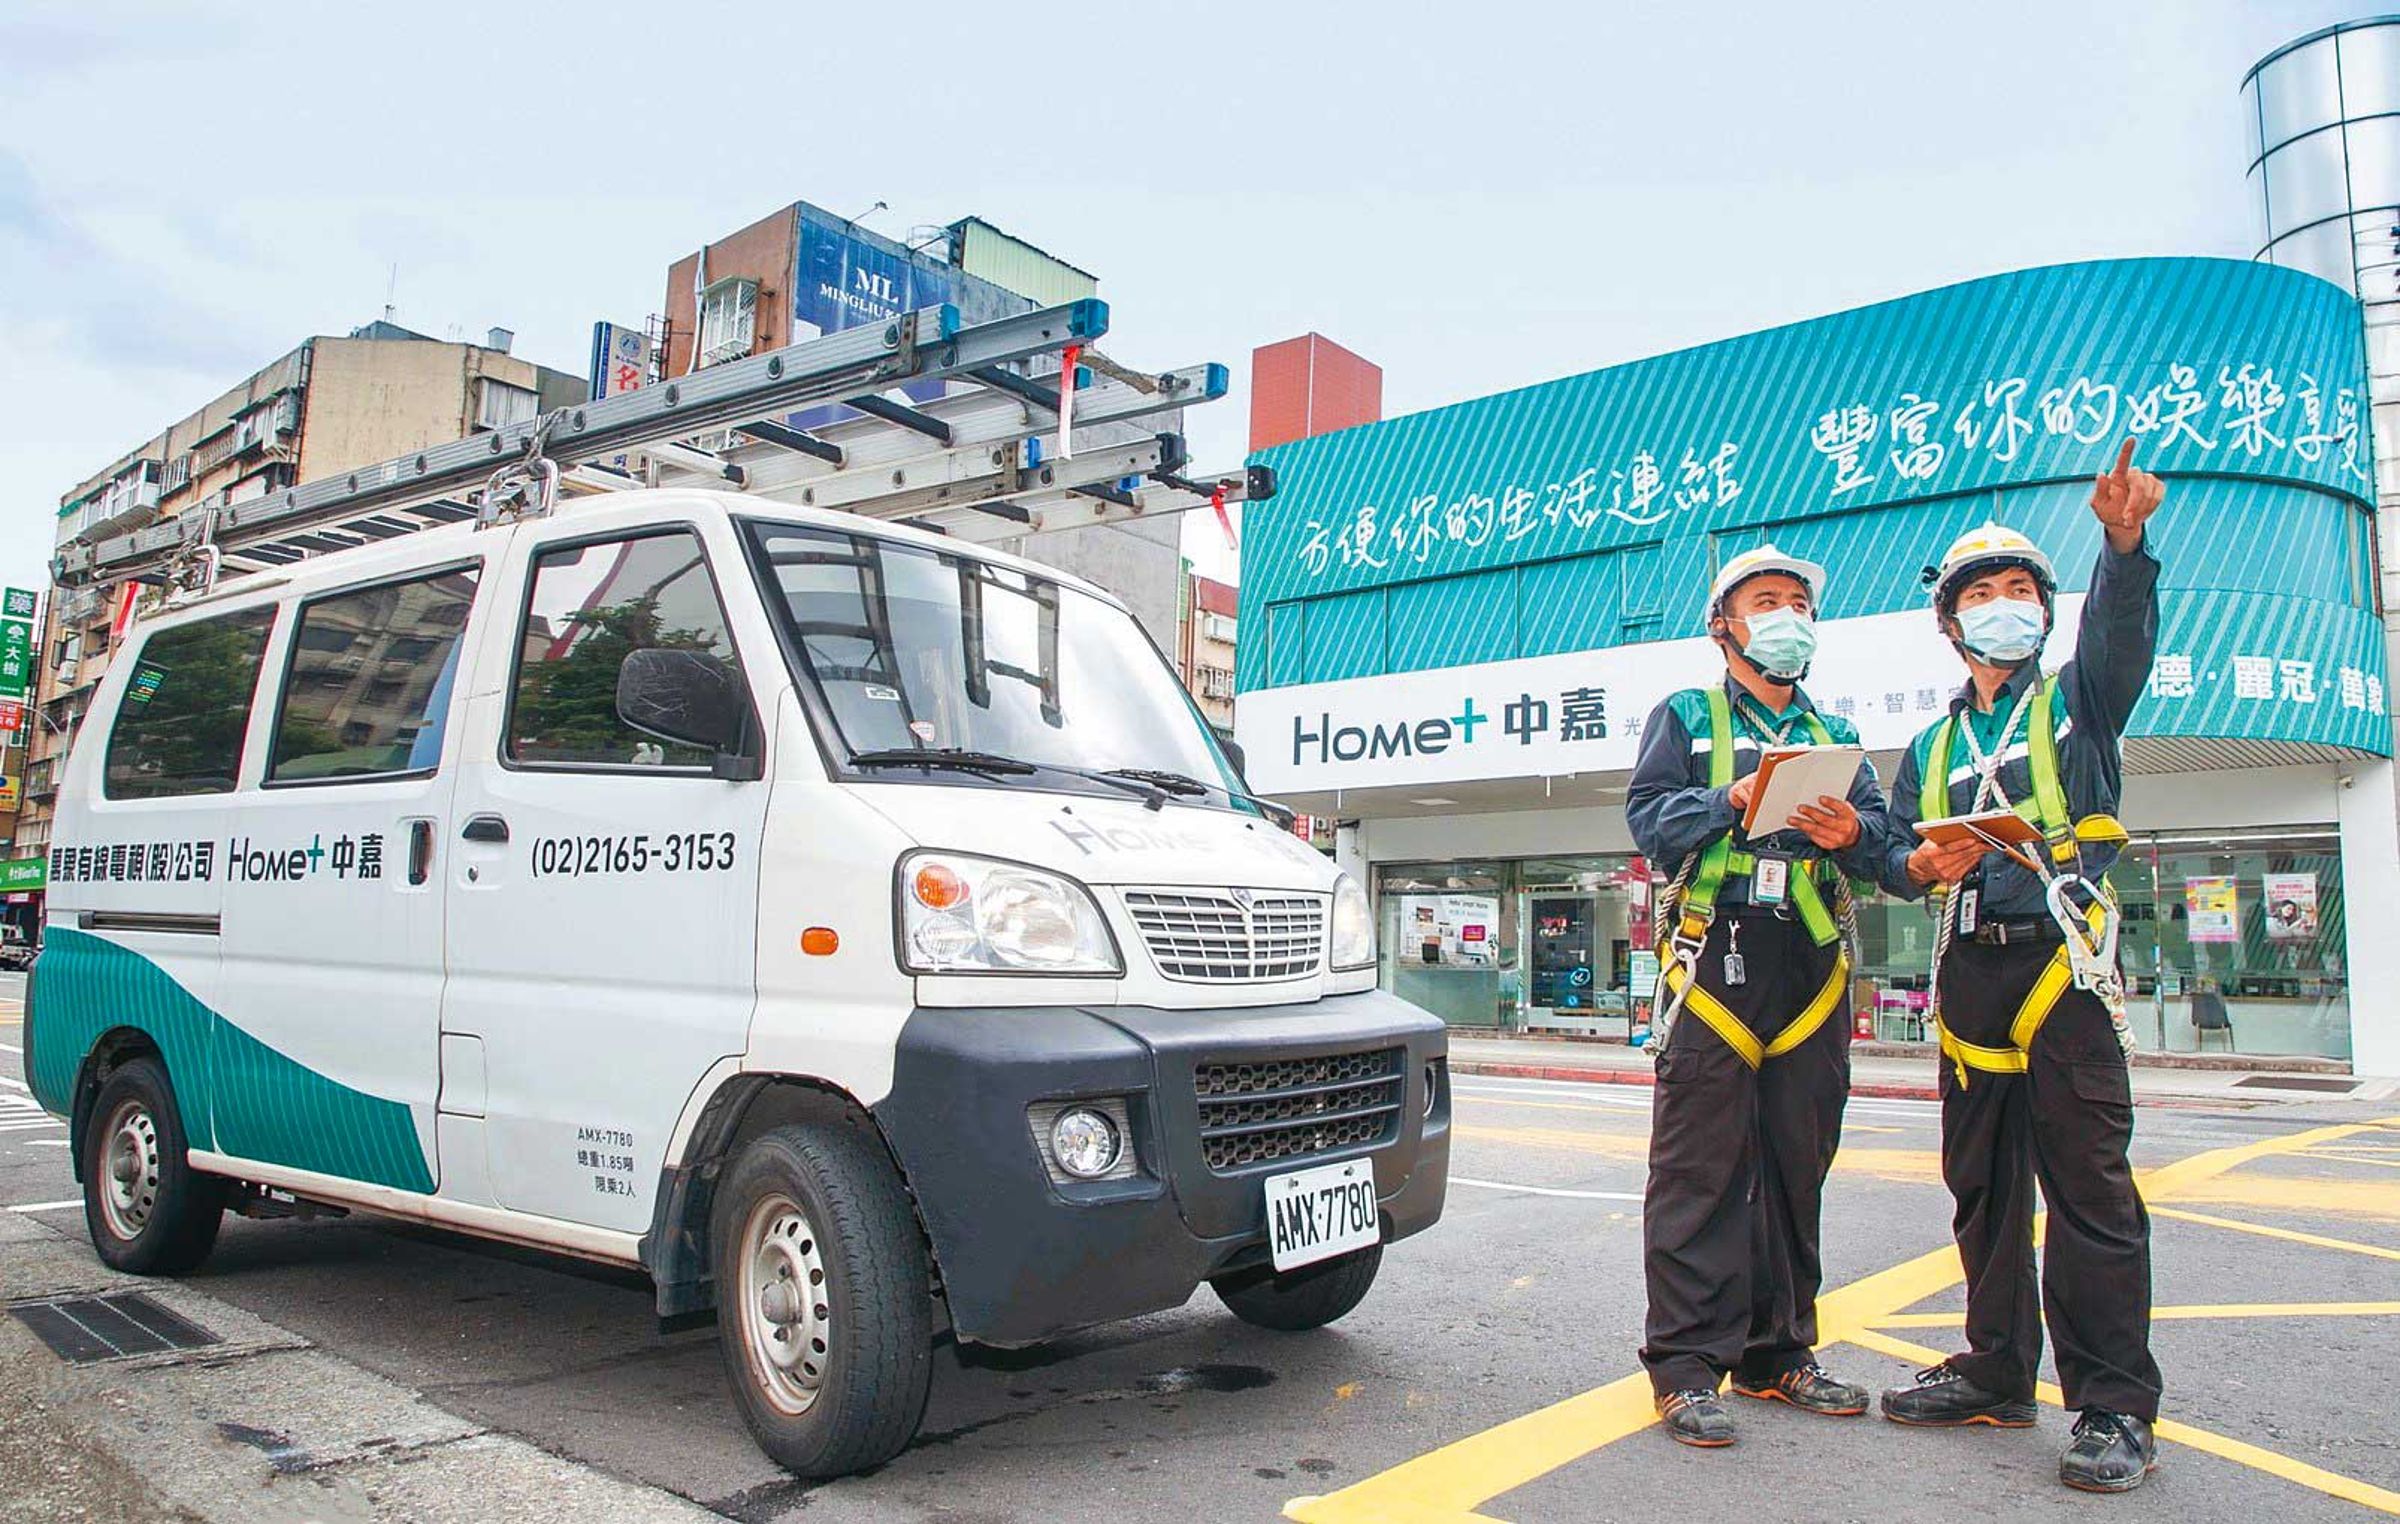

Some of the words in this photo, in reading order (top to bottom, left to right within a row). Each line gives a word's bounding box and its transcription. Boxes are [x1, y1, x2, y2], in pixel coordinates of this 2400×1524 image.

[855, 267, 899, 303] ML
[1299, 442, 1744, 576] 方便你的生活連結
[1504, 687, 1606, 745] 中嘉
[1625, 717, 1641, 736] 光
[331, 833, 383, 879] 中嘉
[532, 832, 736, 878] (02)2165-3153
[578, 1127, 632, 1147] AMX-7780
